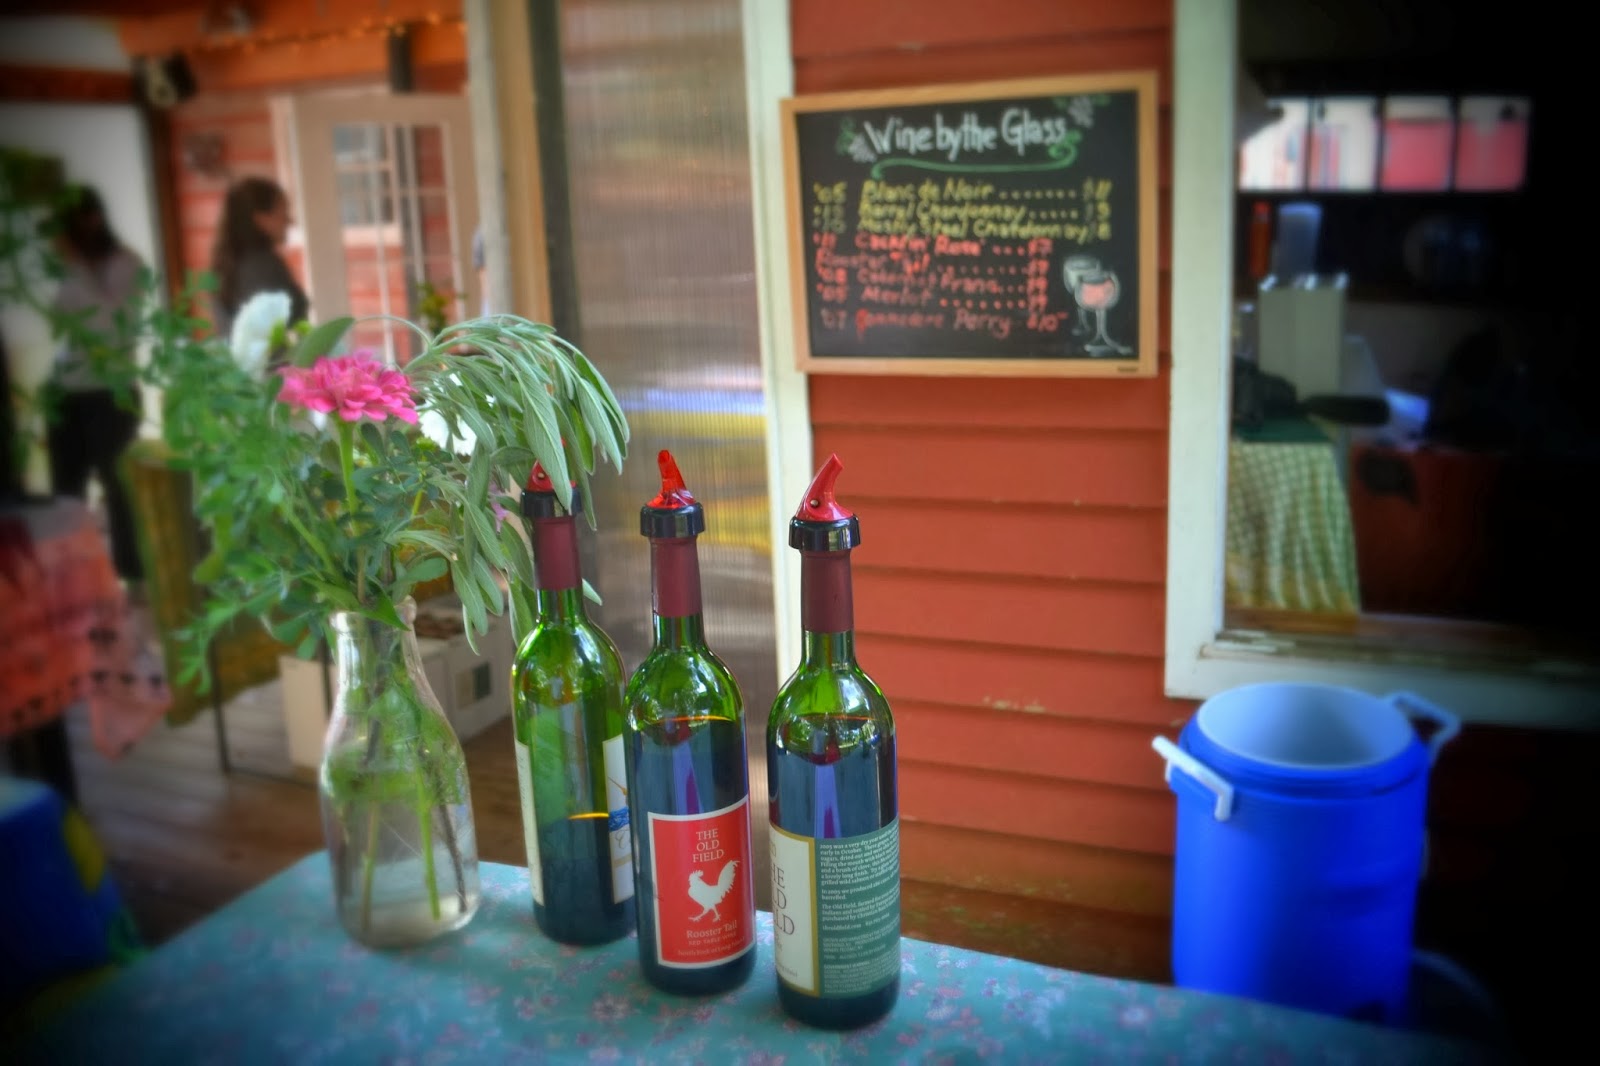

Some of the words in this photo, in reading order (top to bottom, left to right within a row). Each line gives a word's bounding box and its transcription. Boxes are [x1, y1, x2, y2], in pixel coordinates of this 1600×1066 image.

[864, 115, 933, 155] Wine
[935, 112, 961, 161] by
[961, 112, 997, 153] the
[1002, 107, 1066, 156] Glass
[943, 178, 995, 201] Noir
[916, 200, 1027, 225] Chardonnay
[696, 828, 718, 840] THE
[696, 840, 720, 852] OLD
[692, 849, 724, 862] FIELD
[771, 862, 786, 889] HE
[850, 883, 872, 894] produced
[686, 928, 722, 938] Rooster
[723, 920, 737, 932] Tail
